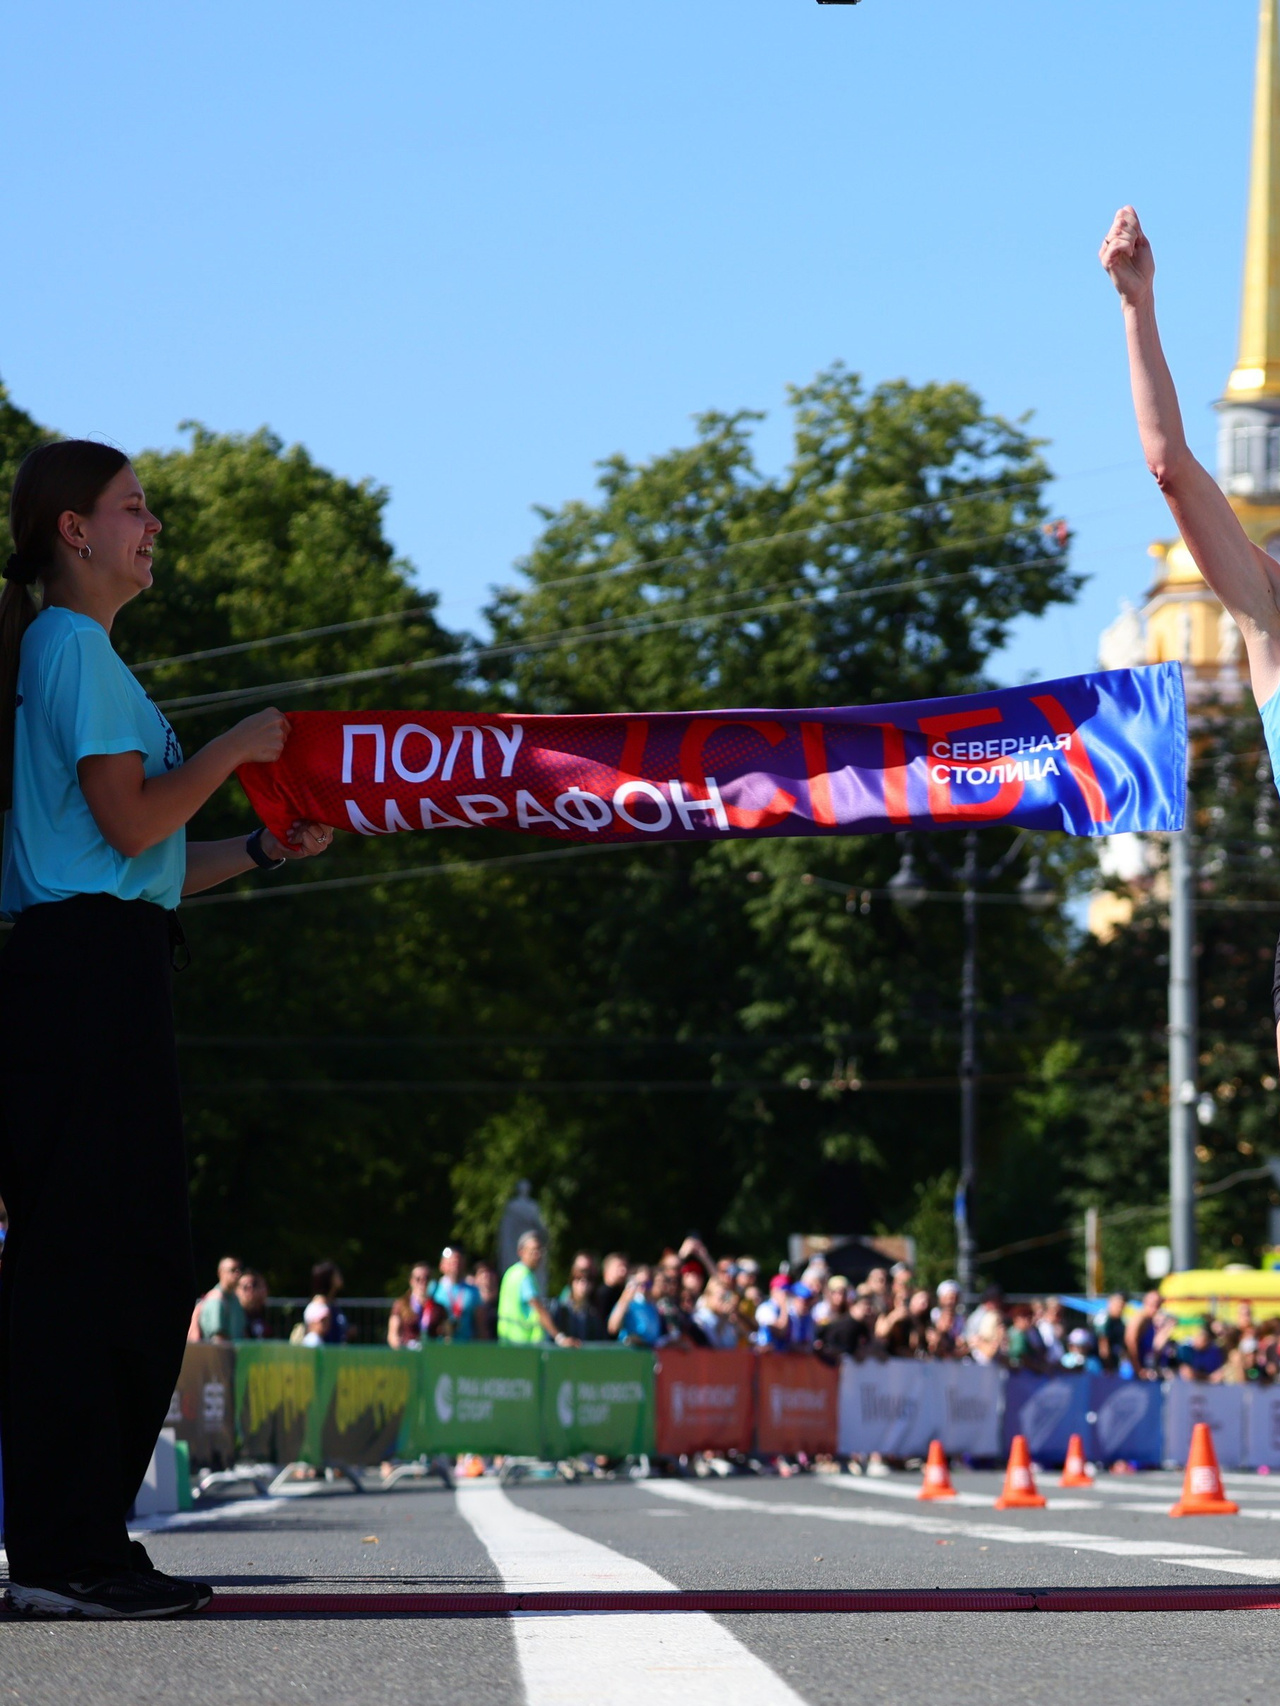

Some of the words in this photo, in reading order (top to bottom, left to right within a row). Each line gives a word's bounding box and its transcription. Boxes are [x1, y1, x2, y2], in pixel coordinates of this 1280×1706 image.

[342, 723, 523, 783] ПОЛУ
[932, 732, 1071, 761] СЕВЕРНАЯ
[931, 758, 1060, 785] СТОЛИЦА
